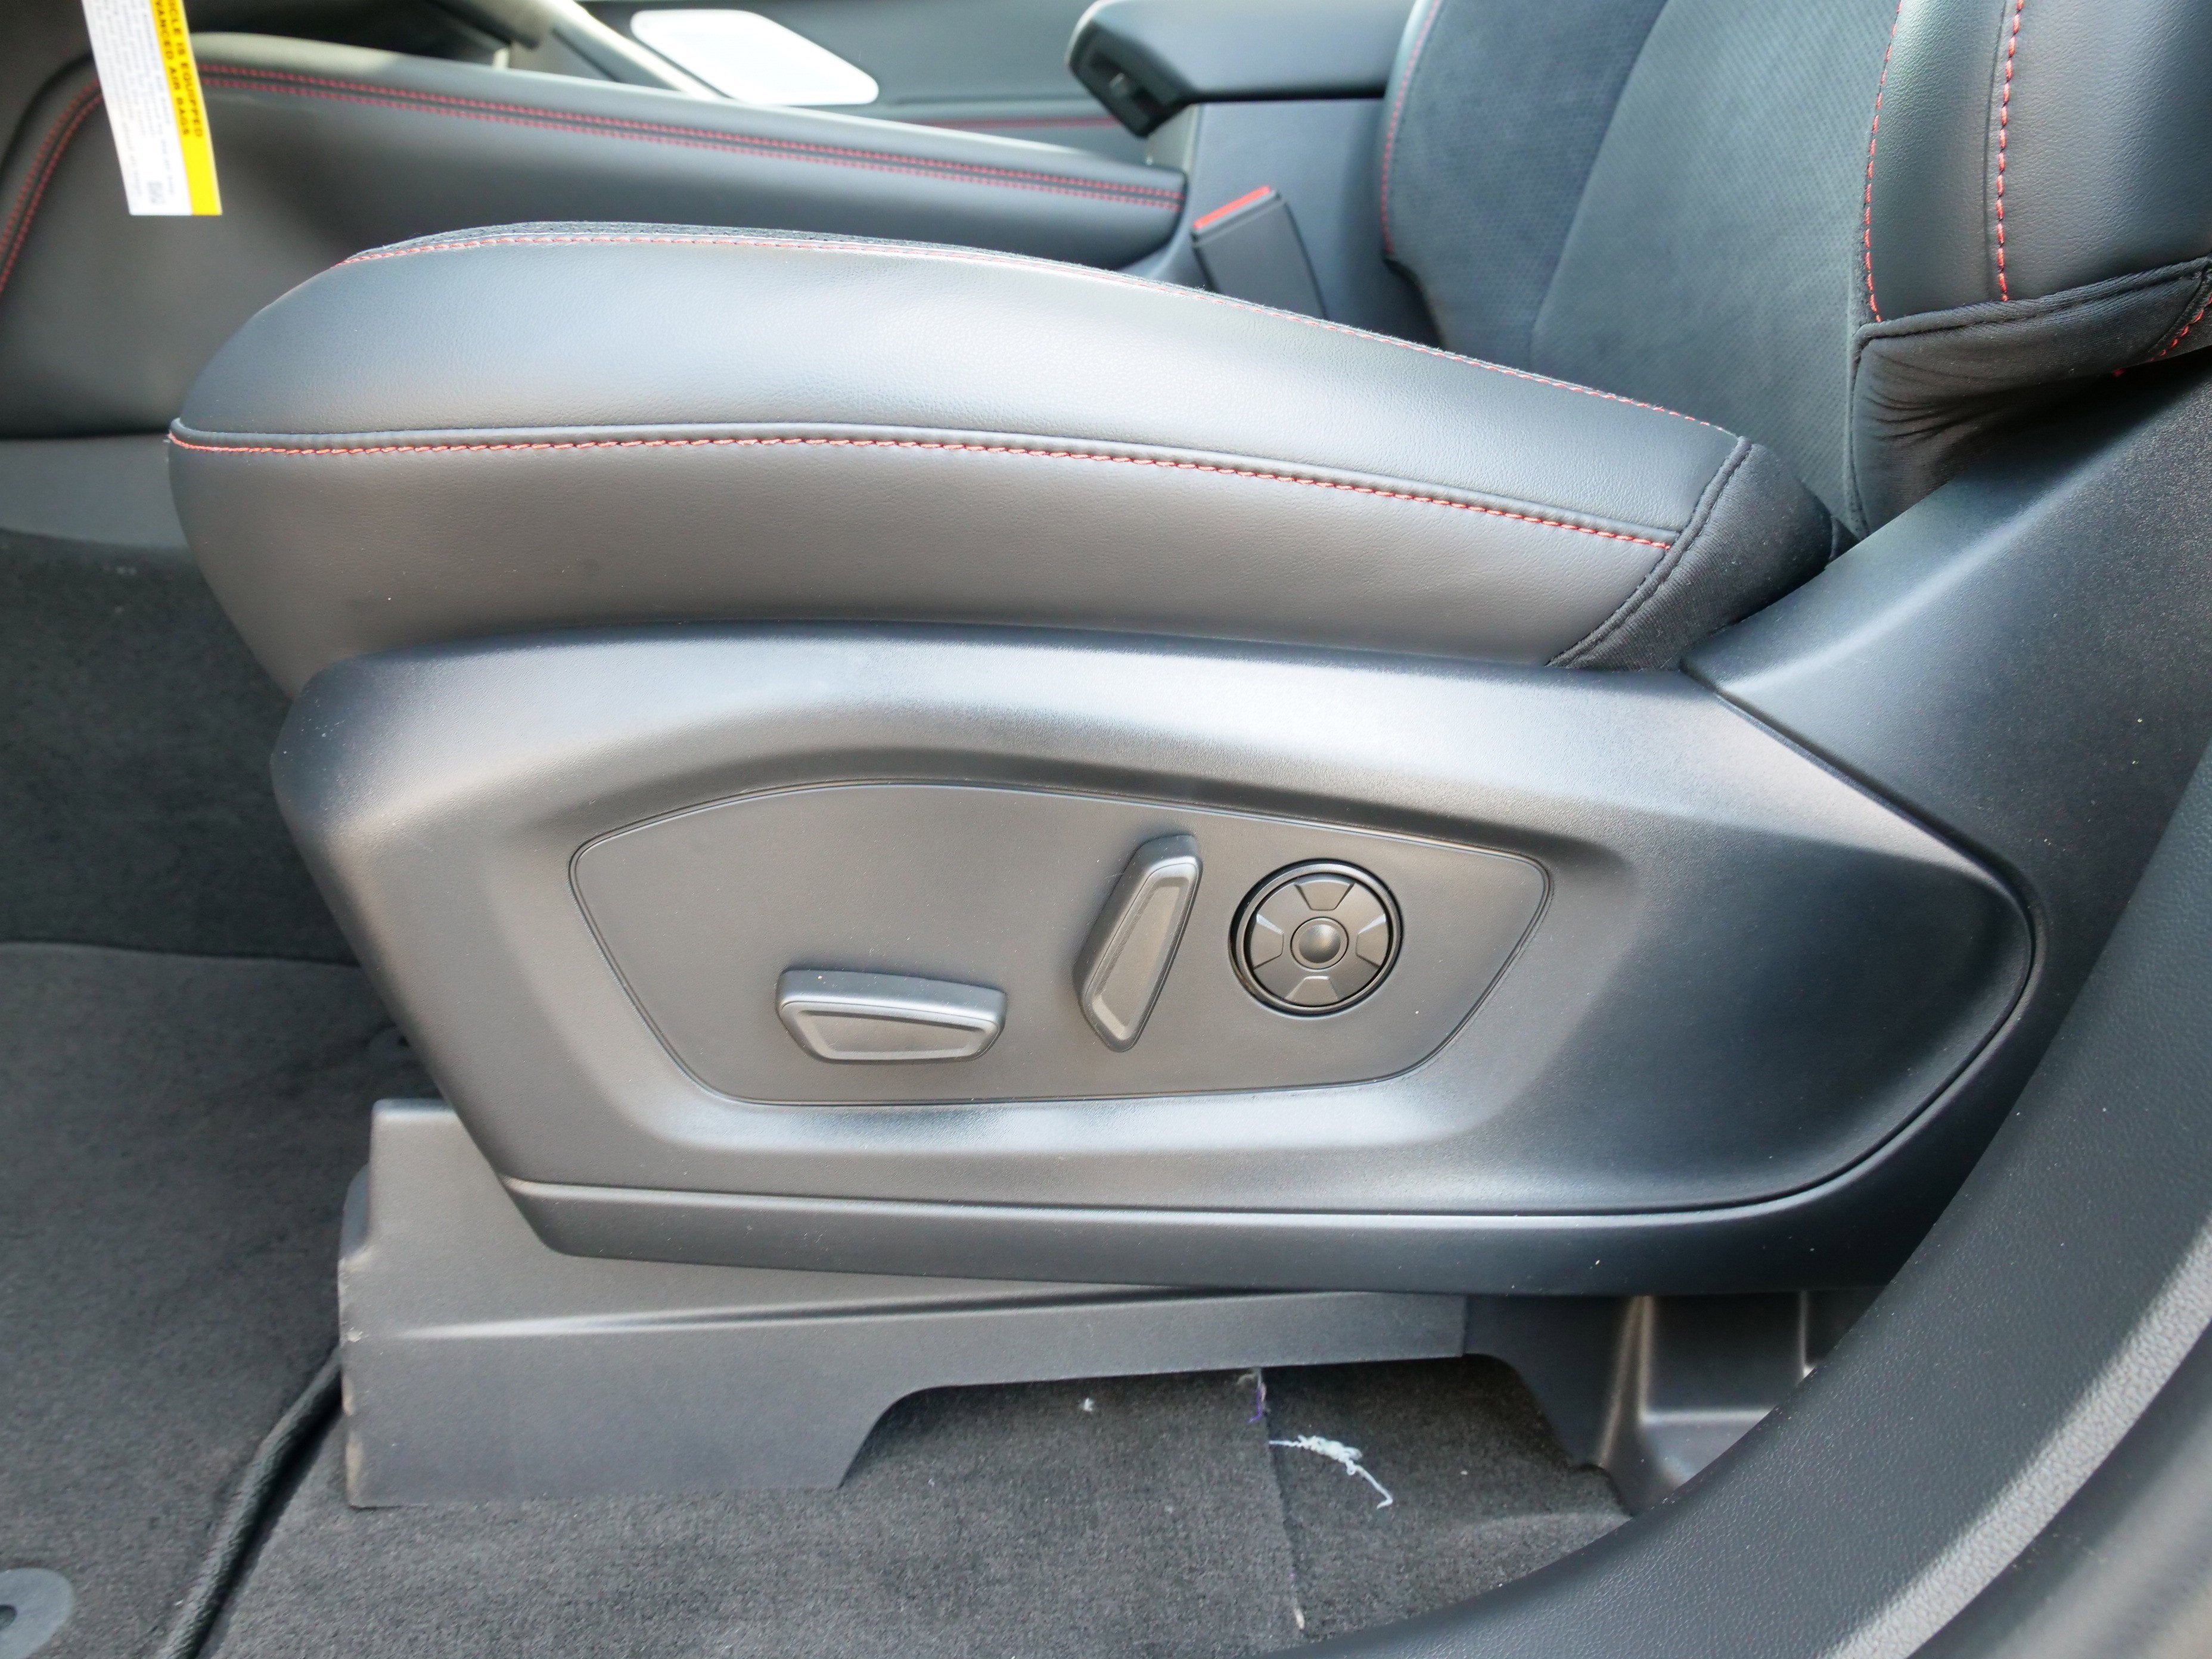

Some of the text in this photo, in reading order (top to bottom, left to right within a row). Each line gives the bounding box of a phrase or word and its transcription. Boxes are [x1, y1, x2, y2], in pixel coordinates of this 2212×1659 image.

[169, 67, 181, 90] AIR
[176, 97, 189, 135] BAGS
[177, 42, 185, 55] IS
[181, 62, 203, 137] EQUIPPED
